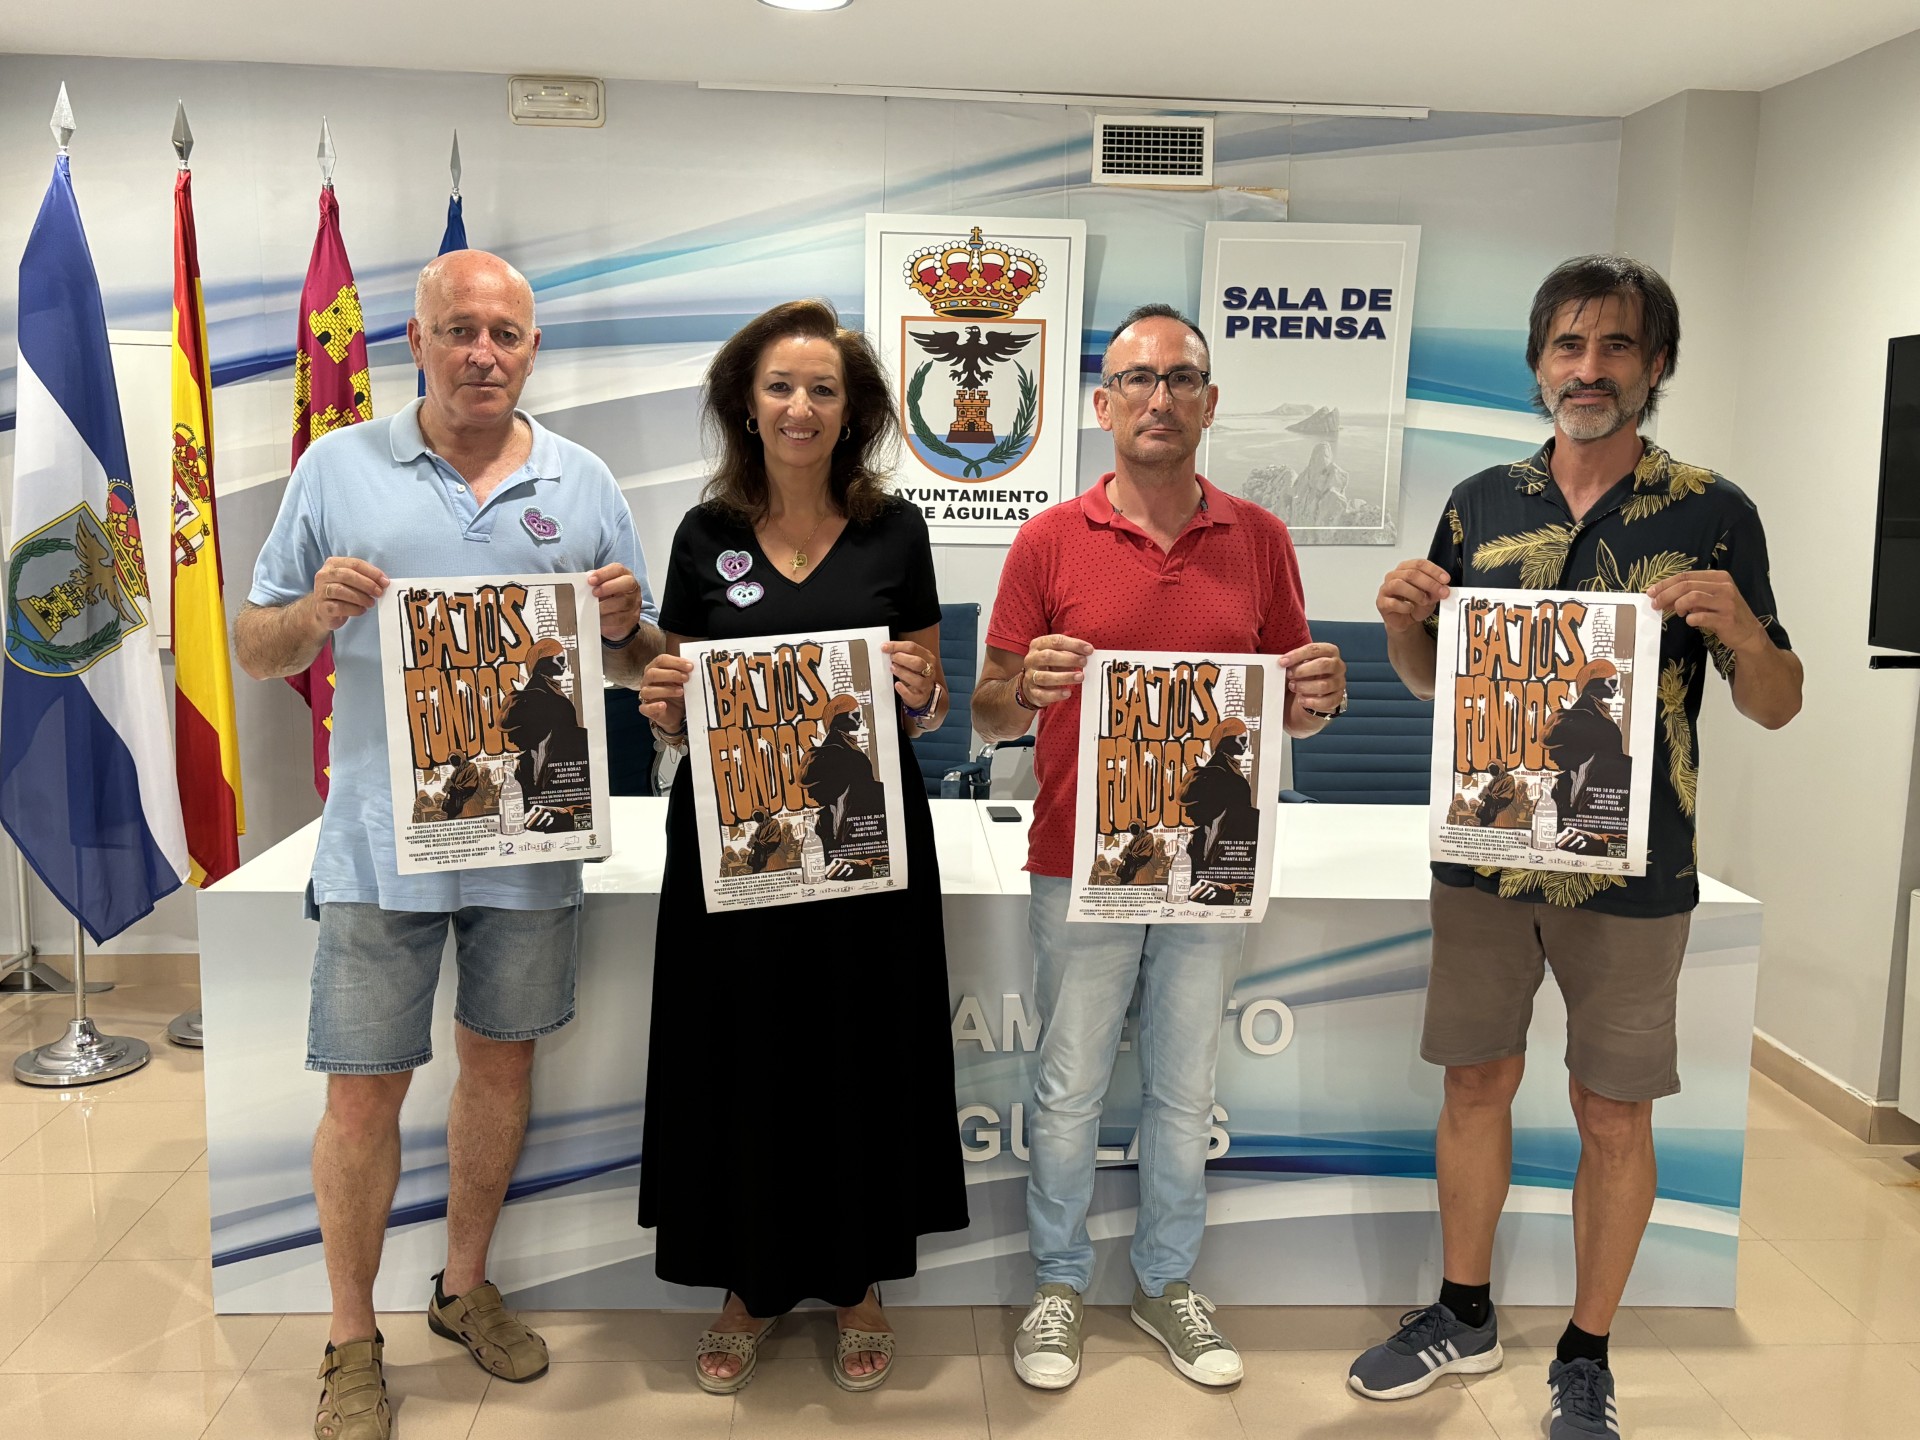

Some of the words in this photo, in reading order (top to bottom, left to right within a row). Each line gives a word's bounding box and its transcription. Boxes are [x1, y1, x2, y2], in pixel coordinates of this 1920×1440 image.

[1223, 286, 1328, 311] SALA
[1341, 288, 1392, 311] DE
[1226, 316, 1386, 339] PRENSA
[943, 504, 1029, 520] ÁGUILAS
[406, 582, 534, 668] BAJOS
[1465, 599, 1588, 681] BAJOS
[710, 642, 831, 728] BAJOS
[1106, 661, 1221, 740] BAJOS
